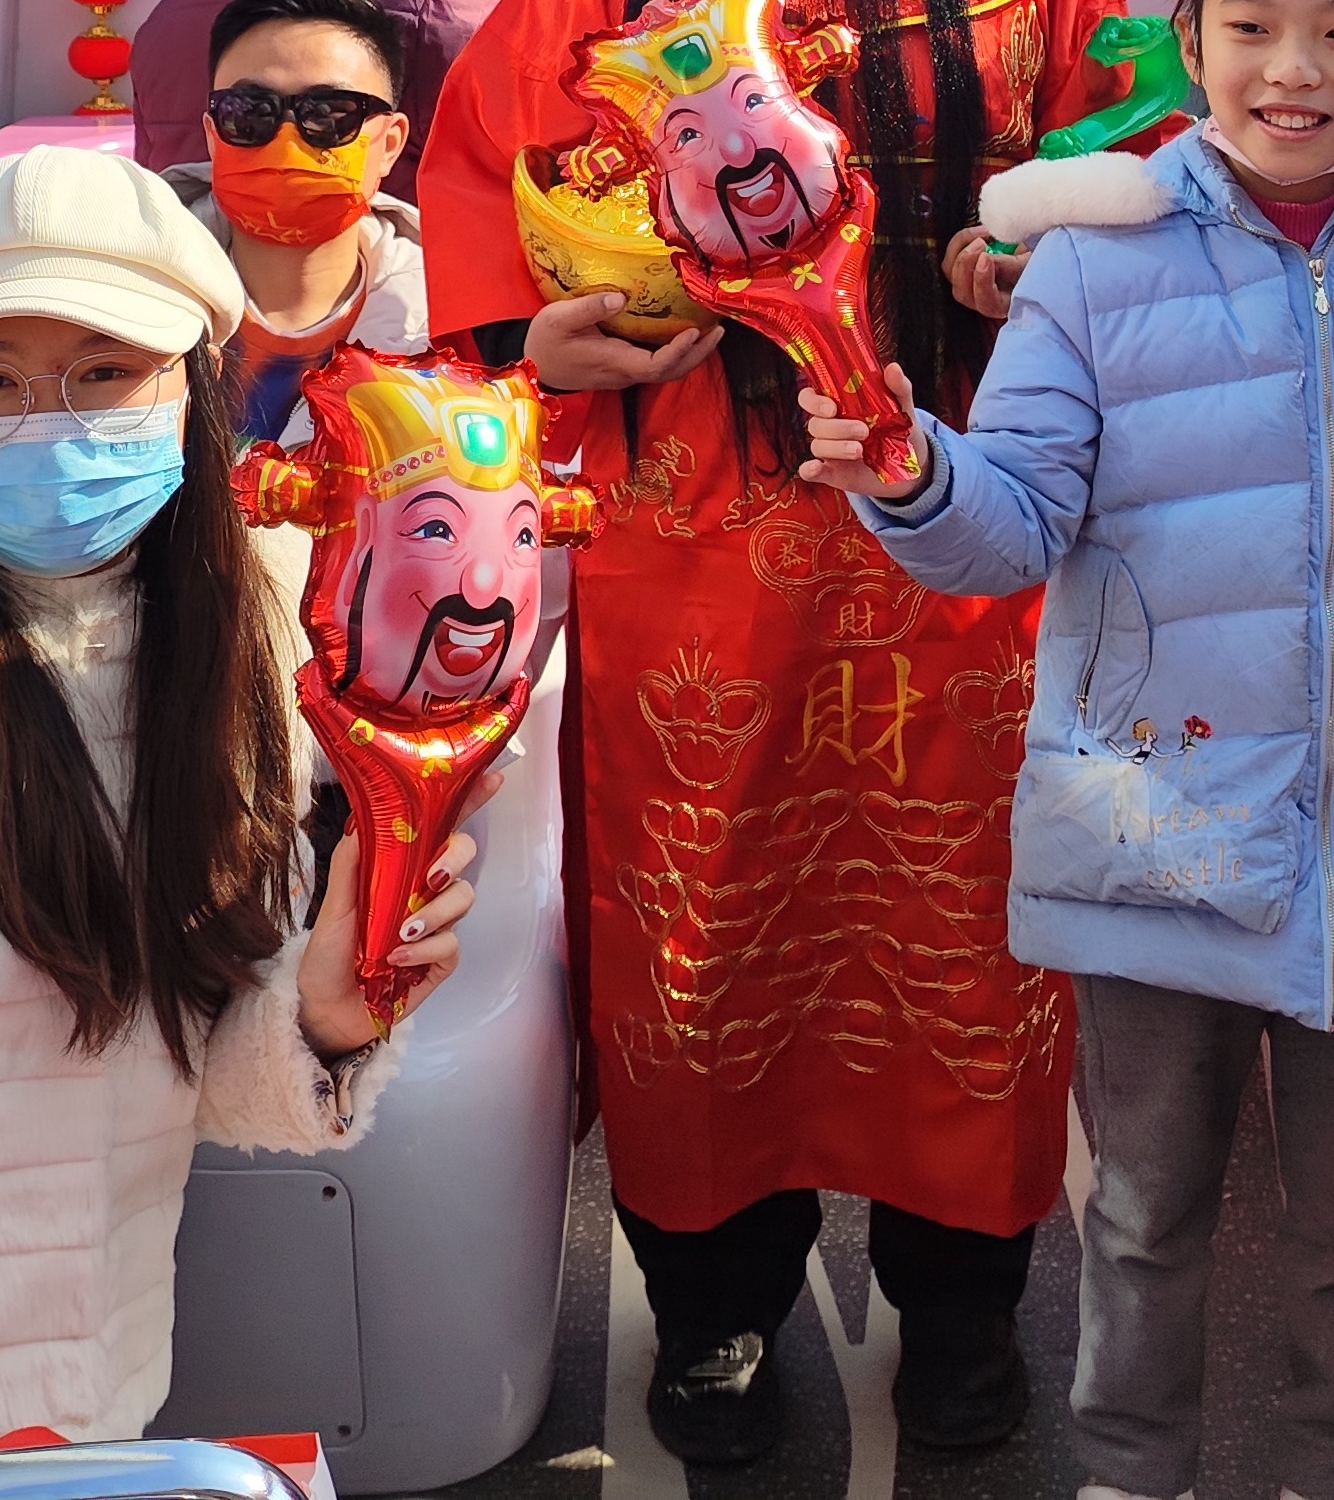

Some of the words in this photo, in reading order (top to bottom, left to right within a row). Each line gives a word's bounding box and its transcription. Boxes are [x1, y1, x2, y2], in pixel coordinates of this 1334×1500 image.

[834, 600, 876, 638] 財
[784, 652, 925, 787] 財
[1143, 803, 1251, 837] ream
[1145, 841, 1244, 892] castle
